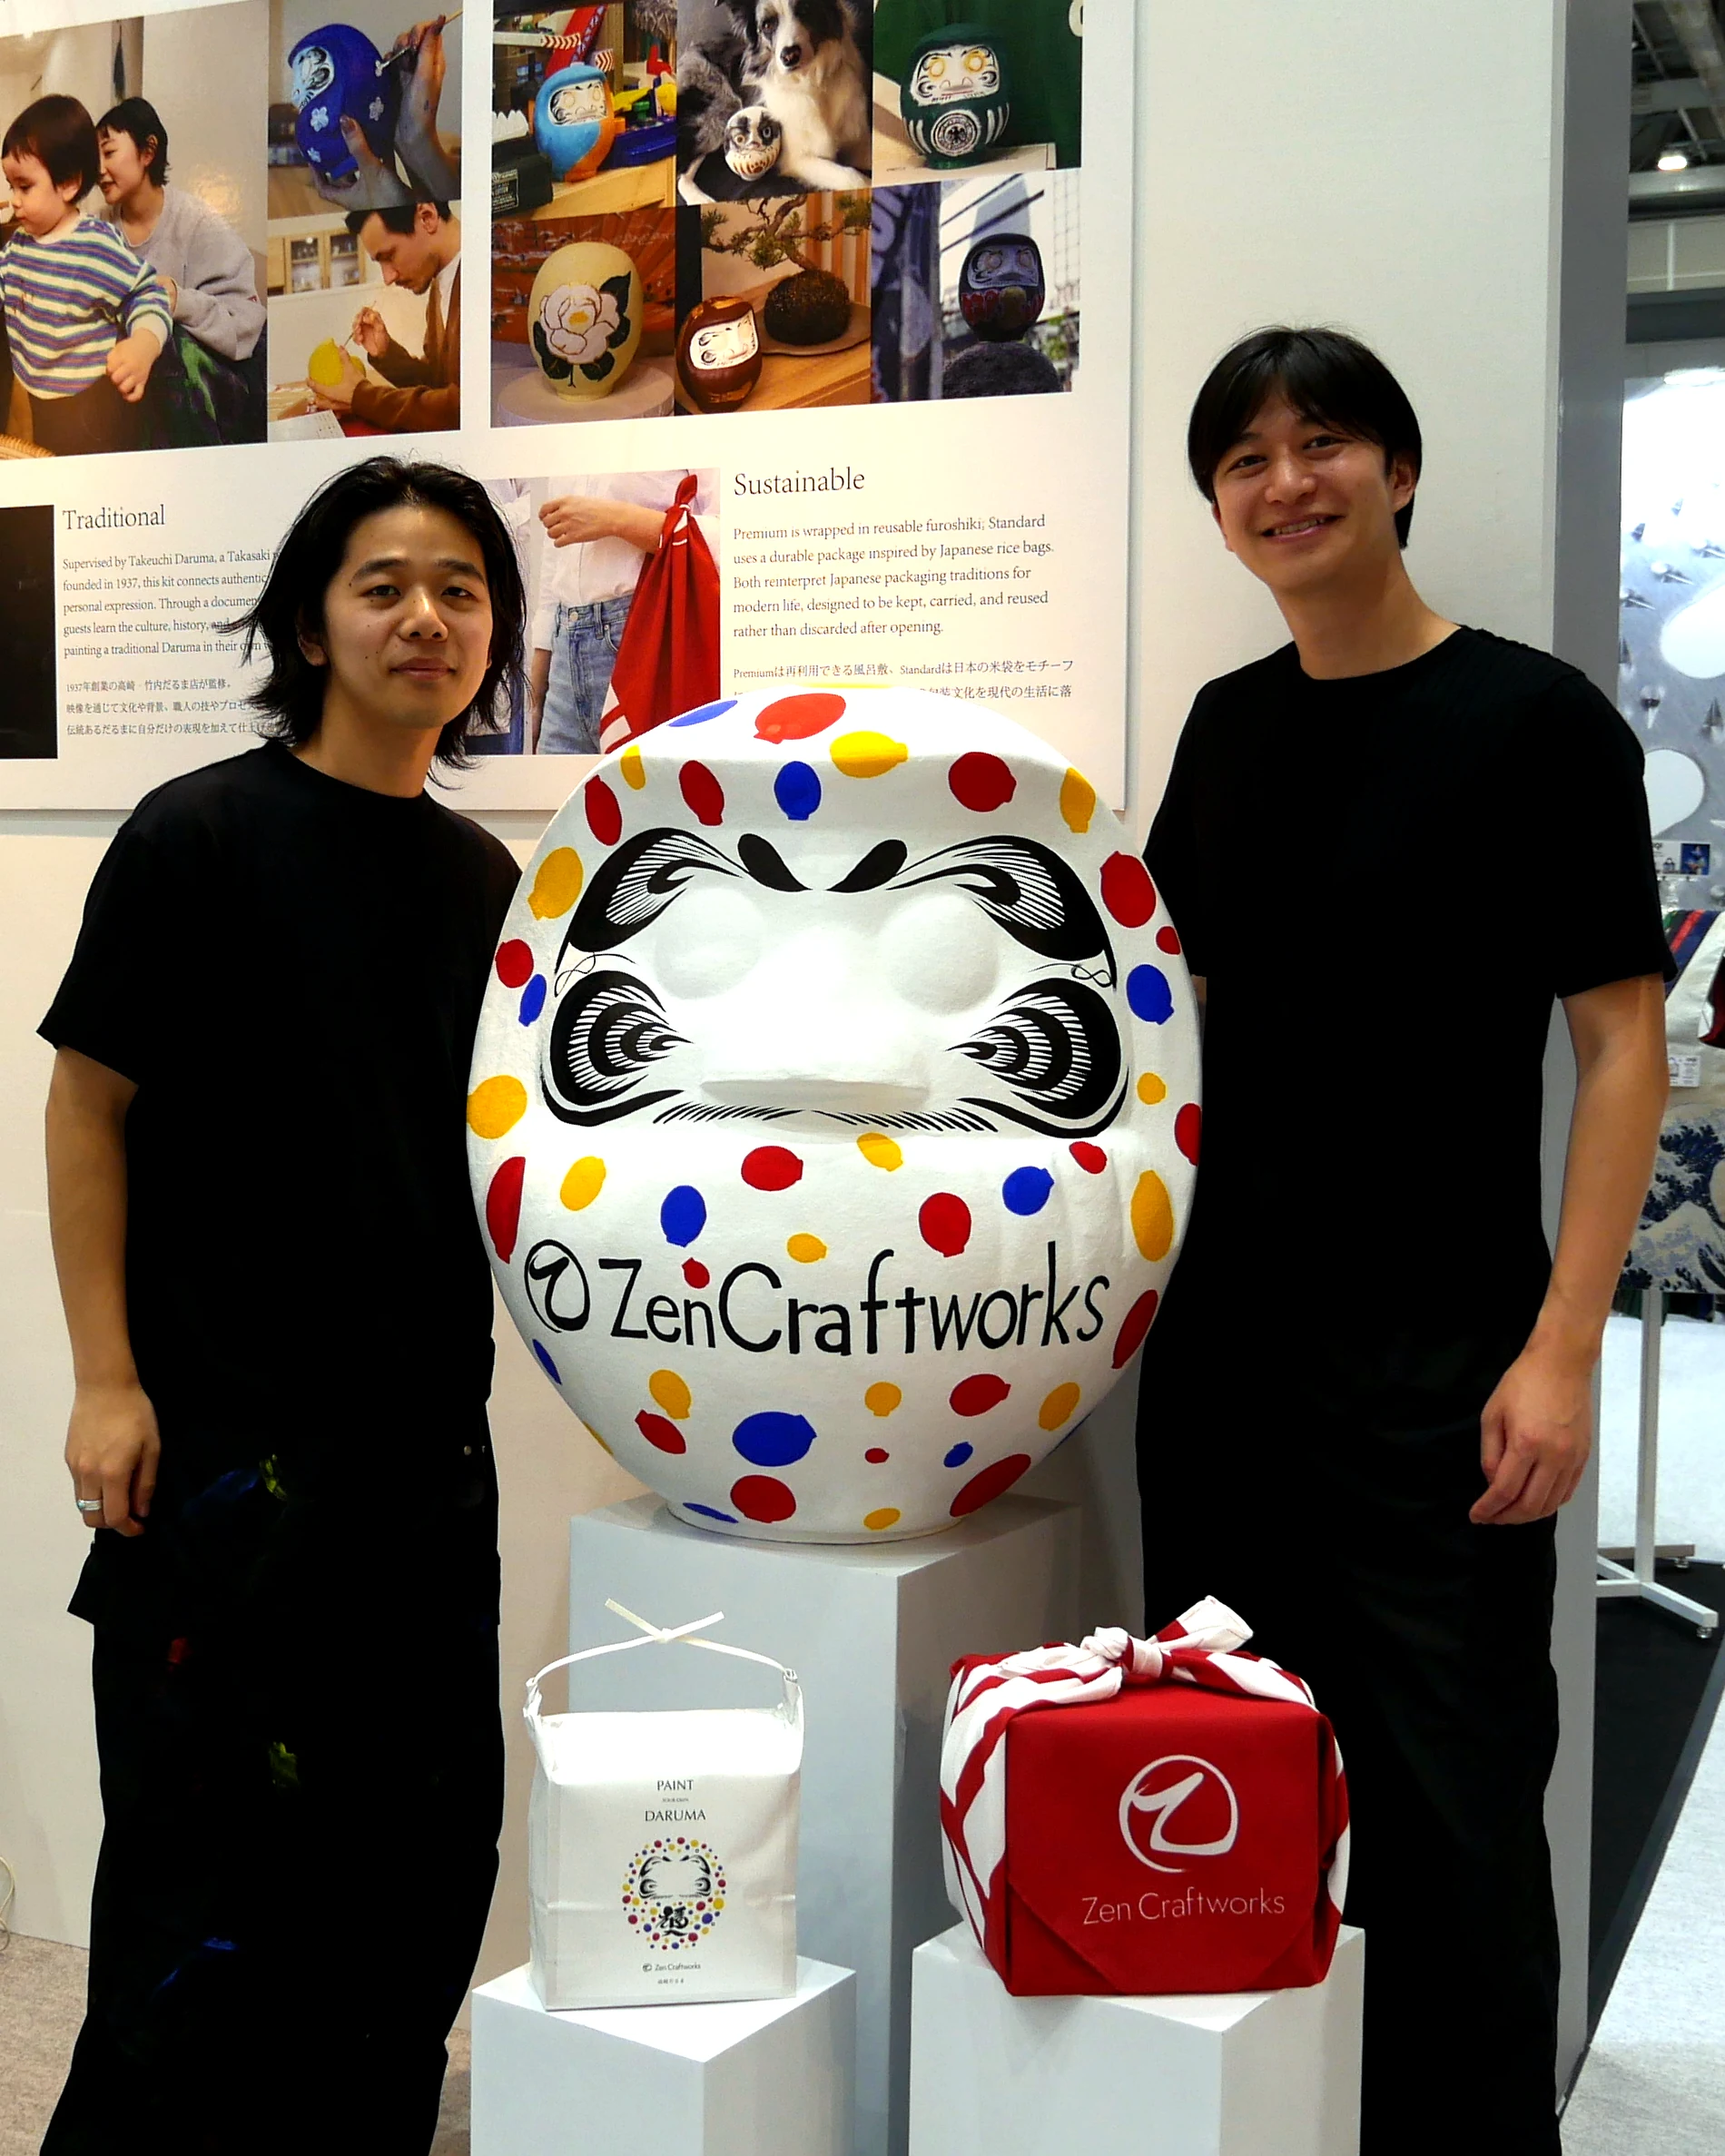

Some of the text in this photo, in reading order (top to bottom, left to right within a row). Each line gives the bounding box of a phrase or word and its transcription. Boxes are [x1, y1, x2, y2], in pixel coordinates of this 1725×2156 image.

[734, 467, 865, 496] Sustainable
[62, 504, 165, 530] Traditional
[734, 514, 1046, 540] Premium is wrapped in reusable furoshiki; Standard
[63, 556, 113, 573] Supervised
[114, 556, 127, 570] by
[128, 554, 172, 566] Takeuchi
[175, 553, 217, 565] Daruma,
[227, 549, 271, 562] Takasaki
[734, 540, 1054, 565] uses a durable package inspired by Japanese rice bags.
[63, 572, 267, 592] founded in 1937, this kit connects authentic
[734, 566, 1031, 590] Both reinterpret Japanese packaging traditions for
[63, 600, 103, 616] personal
[104, 599, 156, 614] expression.
[158, 596, 202, 612] Through
[211, 596, 258, 607] documen
[734, 590, 1049, 615] modern life, designed to be kept, carried, and reused
[63, 625, 92, 638] guests
[93, 622, 116, 633] learn
[118, 621, 133, 633] the
[134, 620, 171, 633] culture,
[173, 619, 209, 634] history,
[734, 619, 943, 637] rather than discarded after opening.
[64, 644, 103, 659] painting
[104, 646, 109, 655] a
[111, 642, 159, 655] traditional
[162, 641, 201, 654] Daruma
[203, 641, 213, 652] in
[215, 640, 237, 652] their
[240, 643, 261, 651] on
[656, 1779, 694, 1791] PAINT
[645, 1808, 706, 1822] DARUMA
[1082, 1886, 1285, 1925] Zen Craftworks
